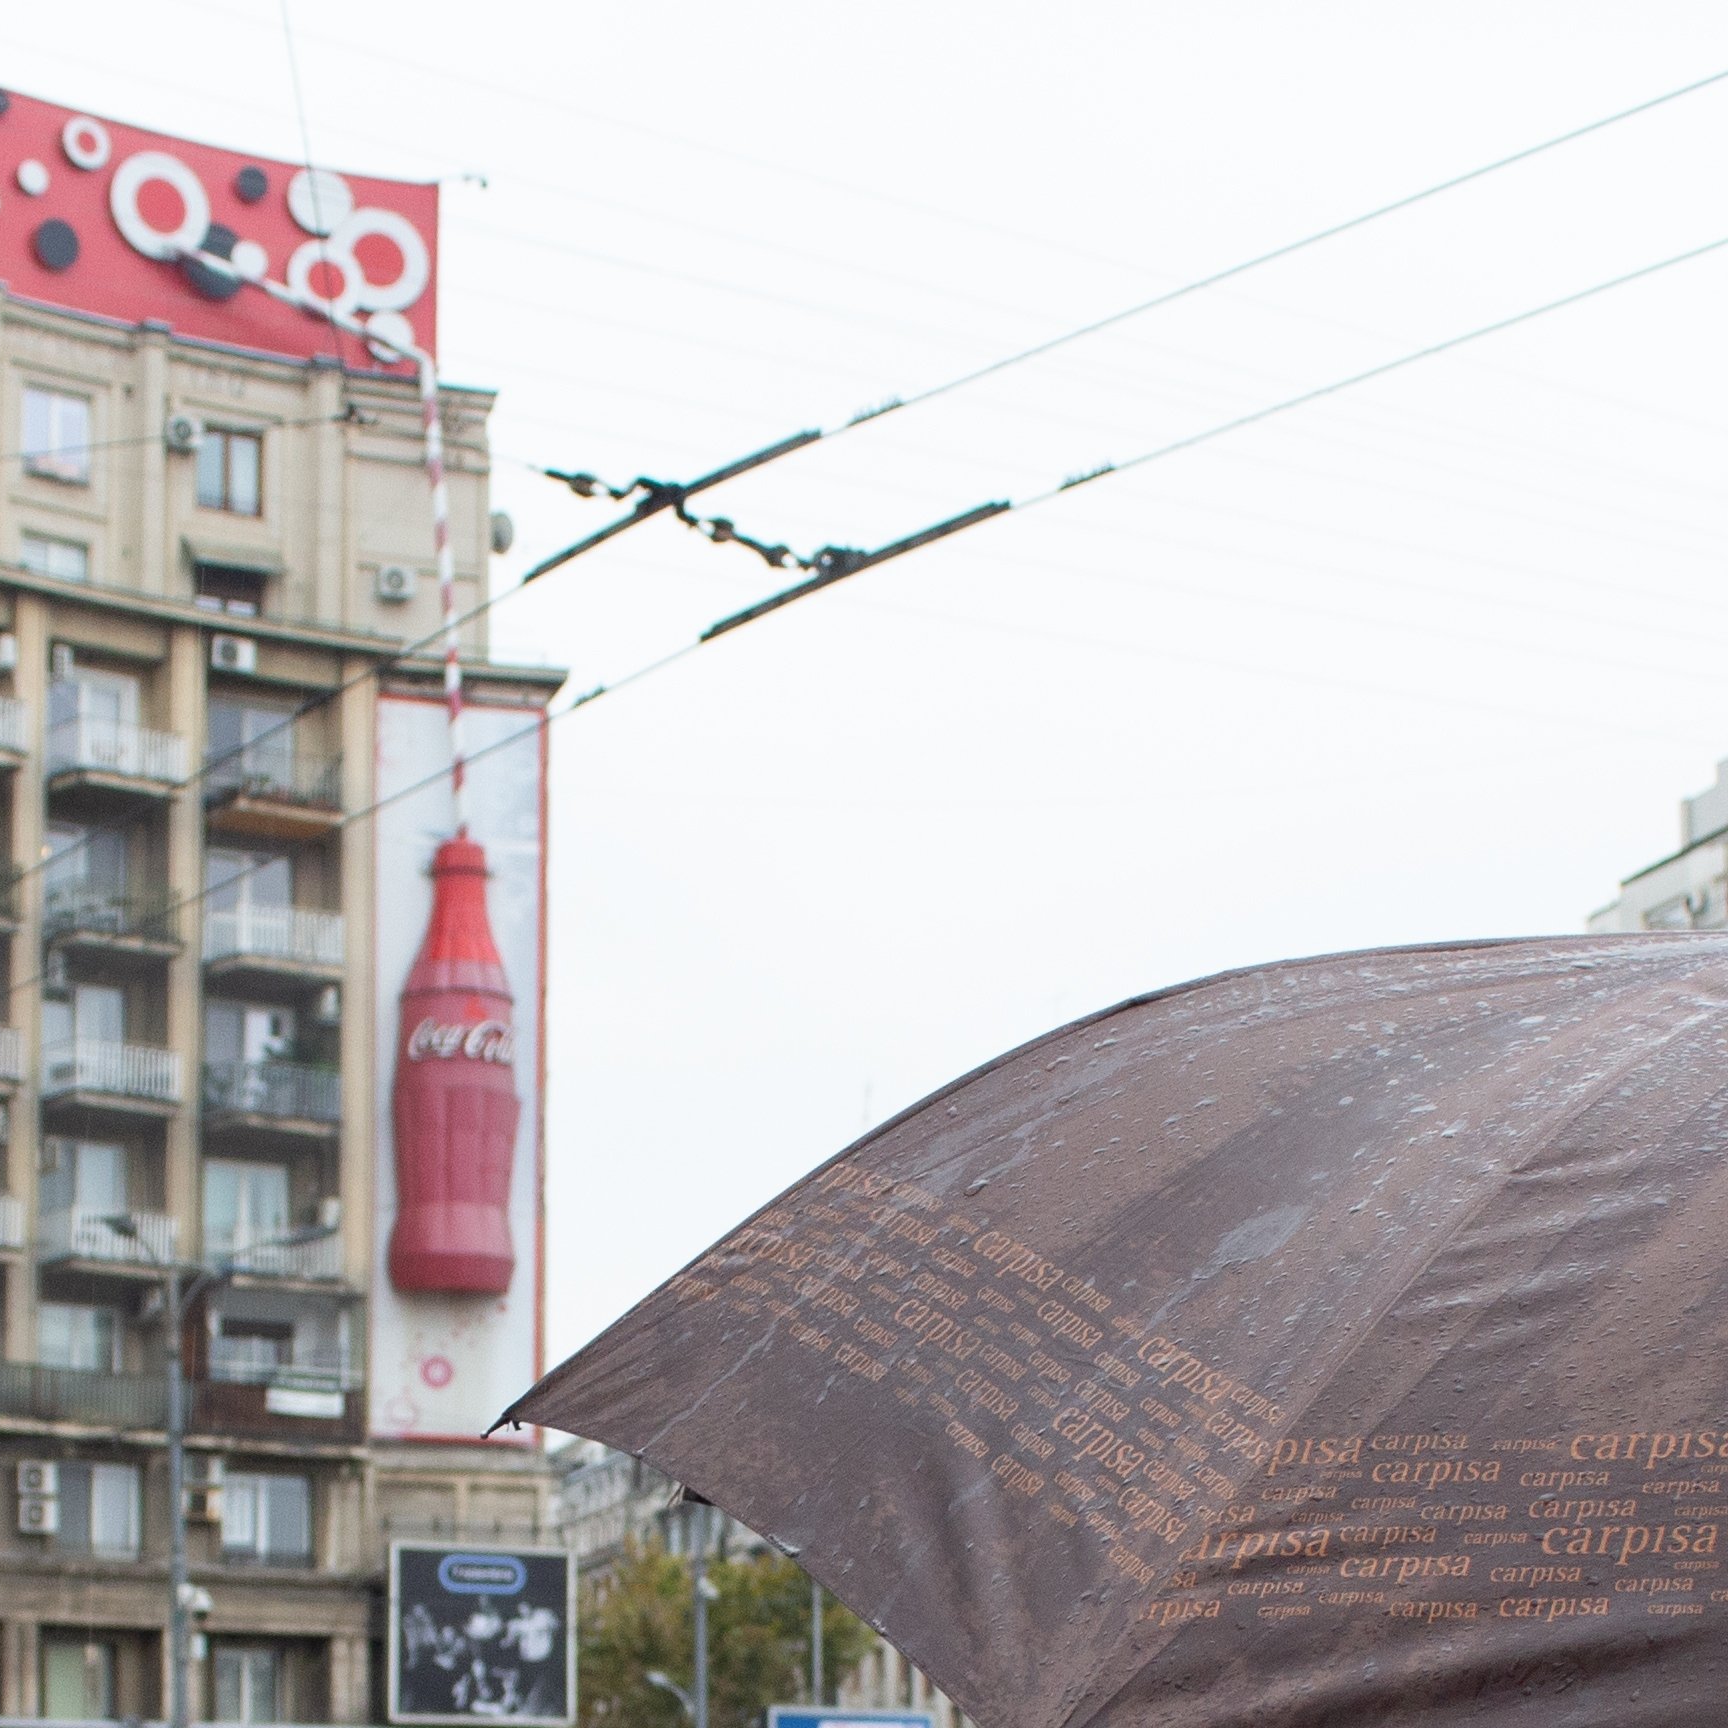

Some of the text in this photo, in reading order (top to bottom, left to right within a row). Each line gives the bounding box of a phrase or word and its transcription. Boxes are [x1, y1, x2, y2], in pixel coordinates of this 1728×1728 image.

[974, 1231, 1064, 1291] carpisa
[1137, 1336, 1233, 1404] carpisa
[1052, 1407, 1145, 1478] carpisa
[1372, 1459, 1502, 1491] carpisa
[1528, 1499, 1637, 1526] carpisa
[1540, 1523, 1719, 1566] carpisa
[1340, 1553, 1471, 1585] carpisa
[1499, 1597, 1610, 1623] carpisa
